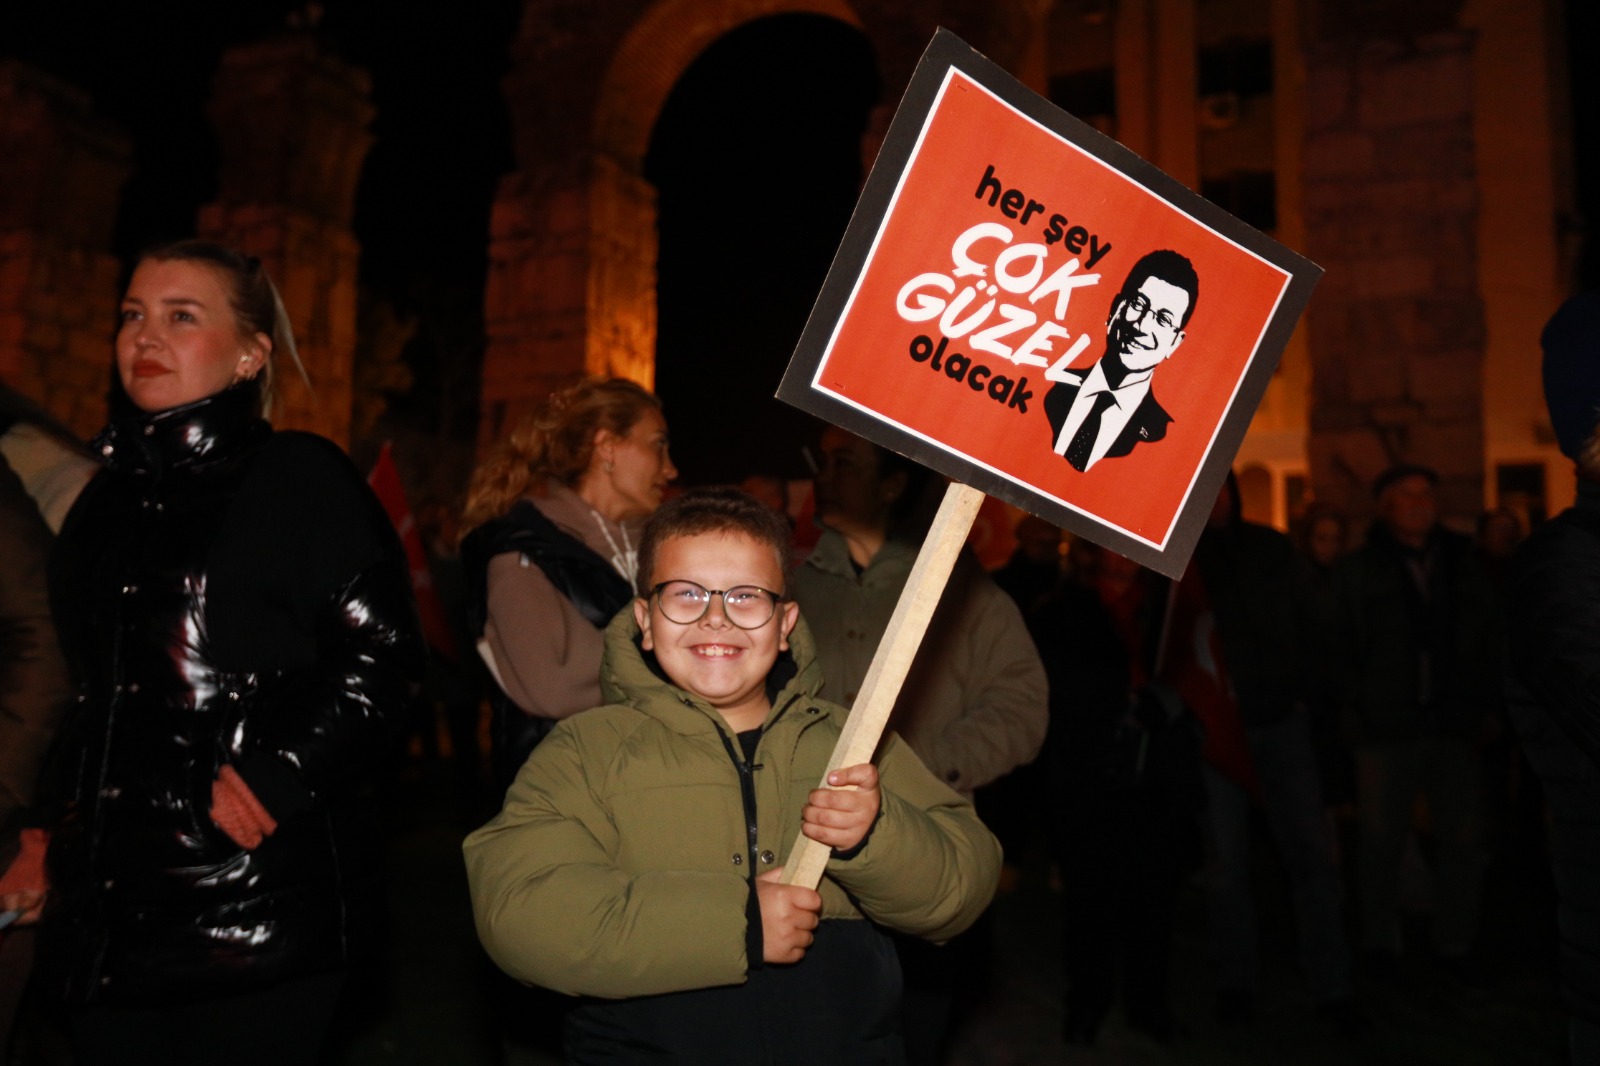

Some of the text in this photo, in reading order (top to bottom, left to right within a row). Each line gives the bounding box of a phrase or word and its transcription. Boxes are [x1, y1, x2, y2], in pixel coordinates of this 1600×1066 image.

[975, 164, 1112, 270] her şey
[951, 222, 1102, 321] ÇOK
[896, 272, 1091, 387] GÜZEL
[909, 335, 1033, 414] olacak
